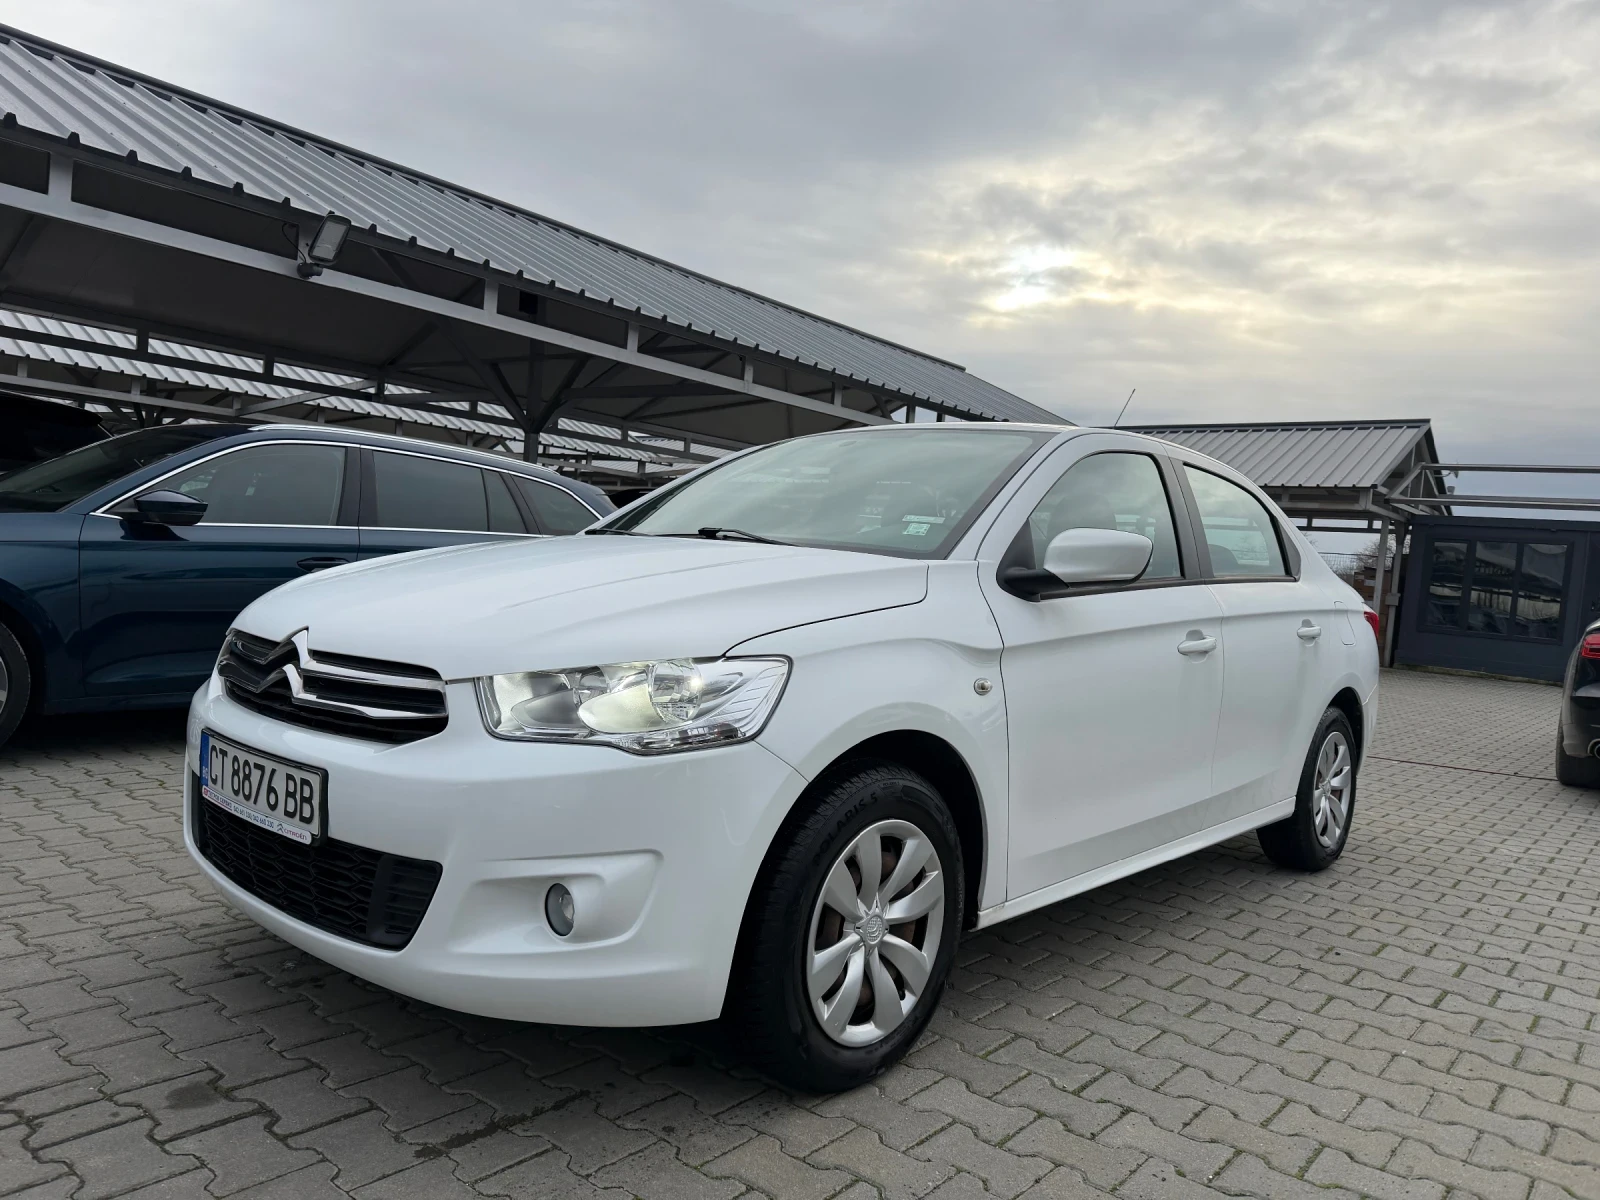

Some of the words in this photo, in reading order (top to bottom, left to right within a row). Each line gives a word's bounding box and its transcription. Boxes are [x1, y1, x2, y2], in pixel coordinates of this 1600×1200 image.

[210, 744, 228, 790] CT
[231, 755, 278, 812] 8876
[283, 772, 315, 825] BB
[812, 797, 867, 867] POLARIS
[869, 792, 878, 804] 5
